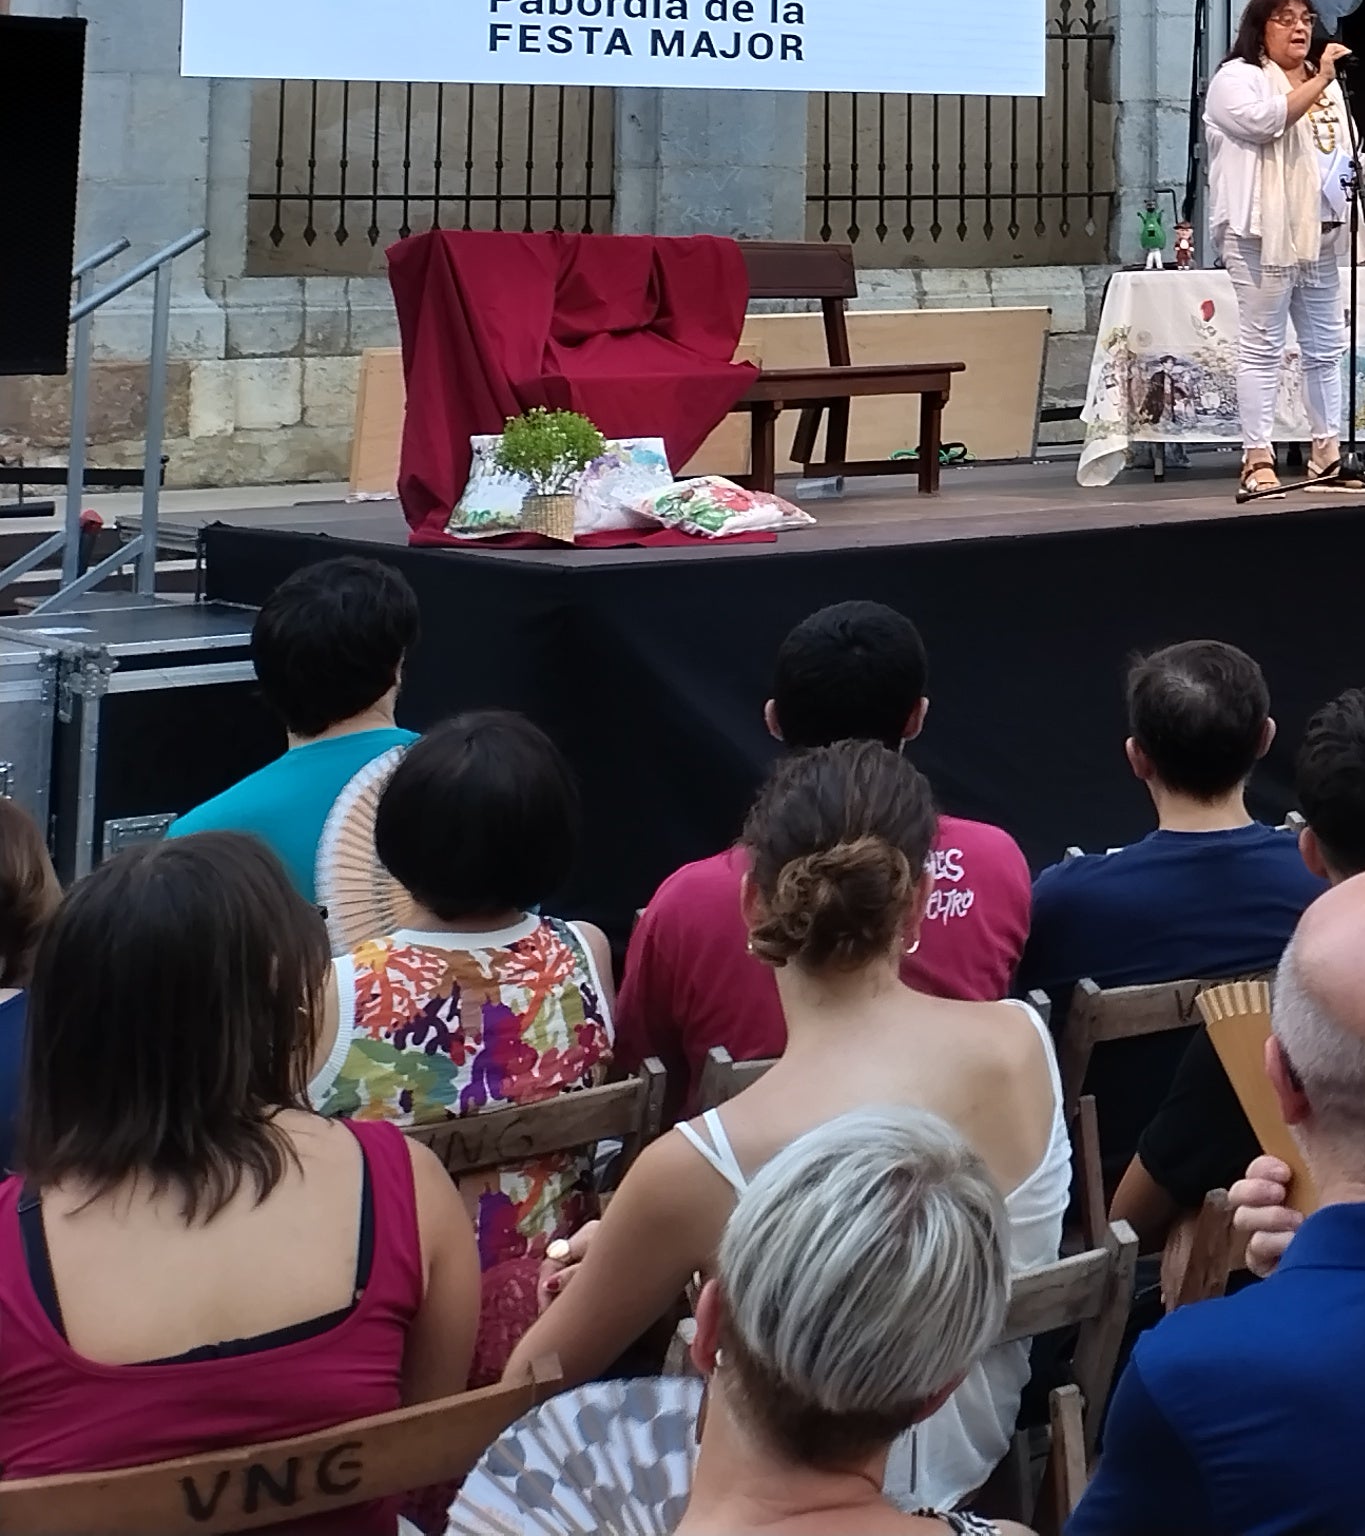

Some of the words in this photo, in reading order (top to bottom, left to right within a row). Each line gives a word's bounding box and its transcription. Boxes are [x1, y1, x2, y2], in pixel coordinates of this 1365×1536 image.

[488, 22, 633, 57] FESTA
[650, 28, 805, 61] MAJOR
[177, 1440, 364, 1523] VNG
